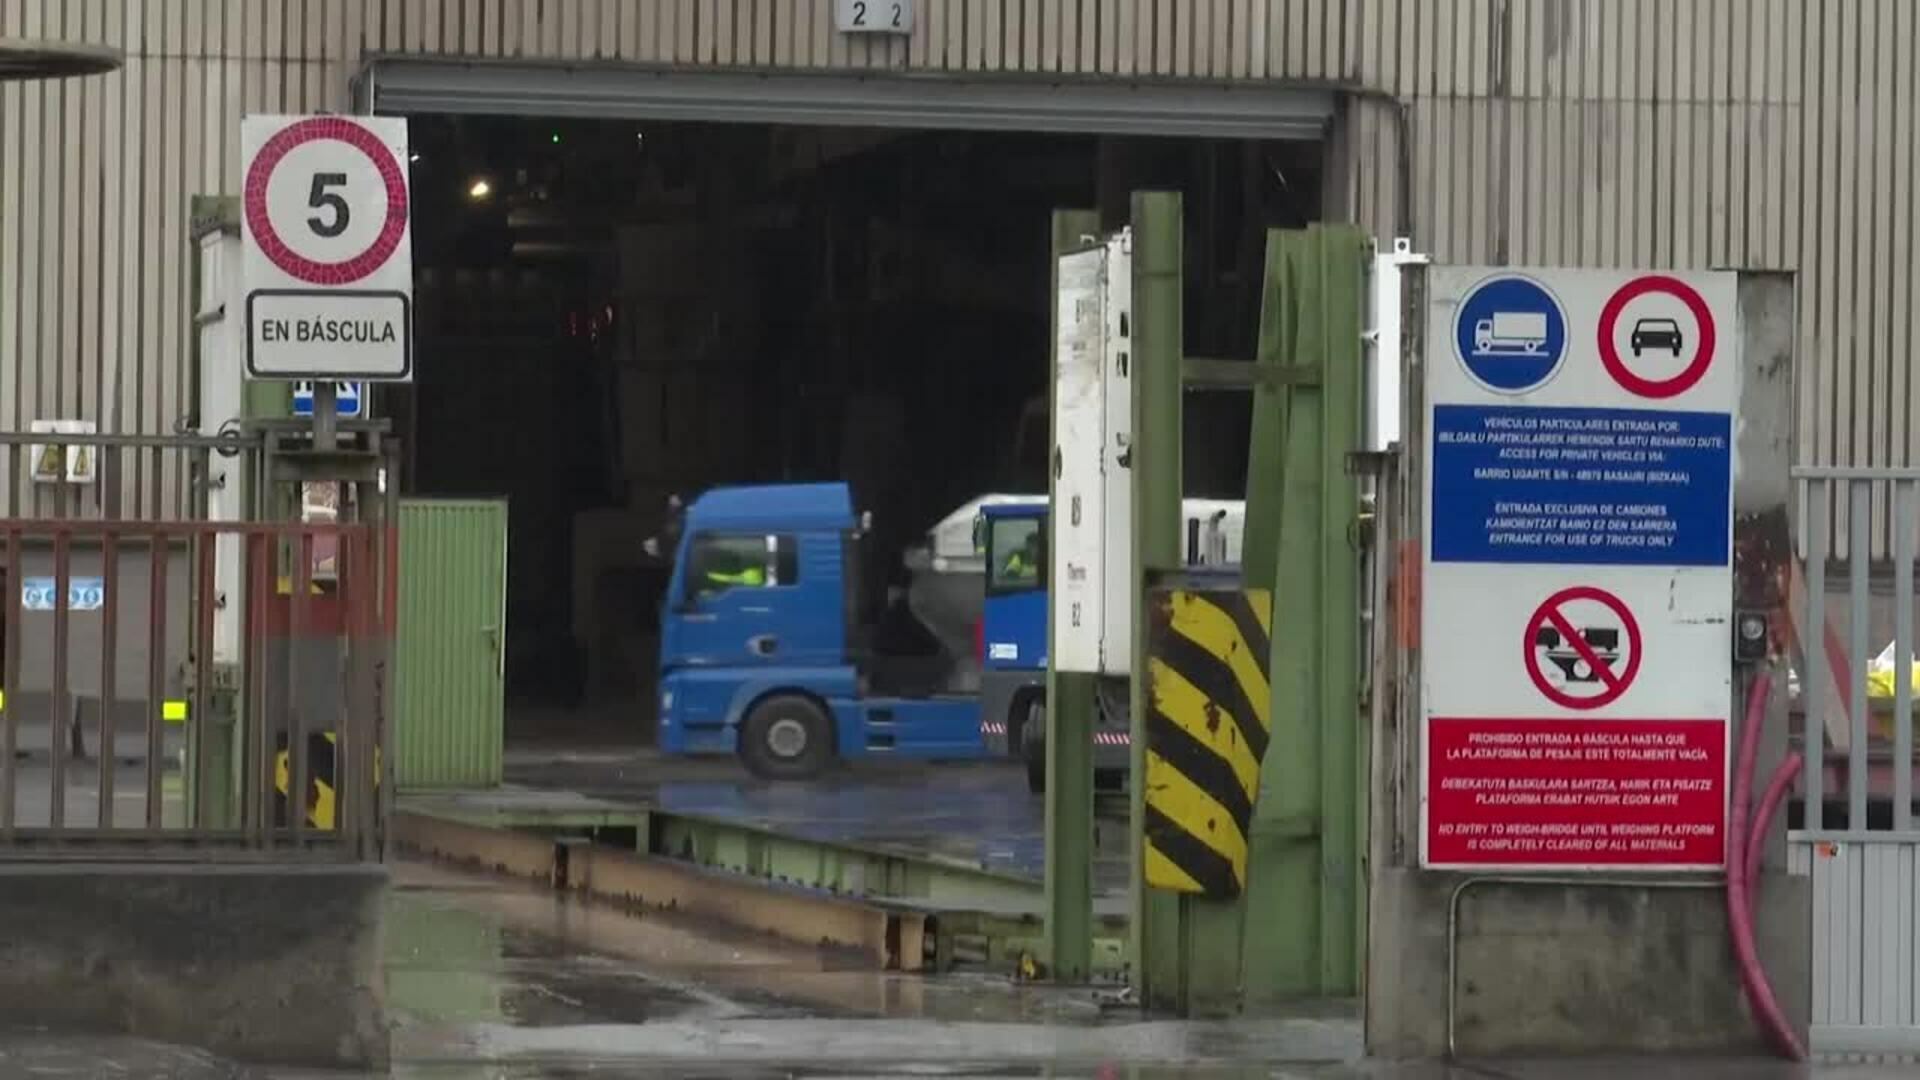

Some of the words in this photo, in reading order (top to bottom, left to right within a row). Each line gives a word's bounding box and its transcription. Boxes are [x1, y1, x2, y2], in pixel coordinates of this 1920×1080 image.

[852, 1, 866, 26] 2
[891, 3, 901, 26] 2
[307, 173, 350, 238] 5
[262, 319, 289, 341] EN
[296, 315, 395, 342] BÁSCULA
[1540, 418, 1610, 430] PARTICULARES
[1612, 419, 1656, 432] ENTRADA
[1499, 448, 1537, 459] ACCESS
[1539, 449, 1559, 459] FOR
[1560, 449, 1600, 460] PRIVATE
[1602, 449, 1646, 461] VEHICLES
[1495, 501, 1542, 514] ENTRADA
[1544, 502, 1598, 515] EXCLUSIVA
[1600, 503, 1614, 515] DE
[1616, 504, 1667, 516] CAMIONES
[1489, 532, 1542, 544] ENTRANCE
[1544, 533, 1566, 545] FOR
[1567, 533, 1587, 545] USE
[1589, 534, 1603, 545] OF
[1606, 534, 1645, 546] TRUCKS
[1647, 535, 1674, 547] ONLY
[1468, 732, 1523, 744] PROHIBIDO
[1525, 733, 1572, 744] ENTRADA
[1573, 733, 1581, 744] A
[1631, 733, 1663, 745] HASTA
[1665, 734, 1686, 745] QUE
[1447, 748, 1460, 759] LA
[1462, 748, 1528, 759] PLATAFORMA
[1529, 748, 1543, 759] DE
[1545, 748, 1582, 760] PESAJE
[1613, 748, 1677, 760] TOTALMENTE
[1475, 793, 1541, 804] PLATAFORMA
[1543, 793, 1583, 804] ERABAT
[1622, 793, 1651, 805] EGON
[1652, 794, 1679, 805] ARTE
[1439, 823, 1454, 834] NO
[1455, 823, 1489, 834] ENTRY
[1491, 823, 1504, 834] TO
[1580, 823, 1608, 835] UNTIL
[1611, 823, 1660, 835] WEIGHING
[1662, 823, 1715, 835] PLATFORM
[1467, 839, 1478, 850] IS
[1480, 838, 1544, 851] COMPLETELY
[1545, 838, 1592, 850] CLEARED
[1594, 839, 1608, 850] OF
[1609, 839, 1629, 850] ALL
[1630, 839, 1686, 850] MATERIALS
